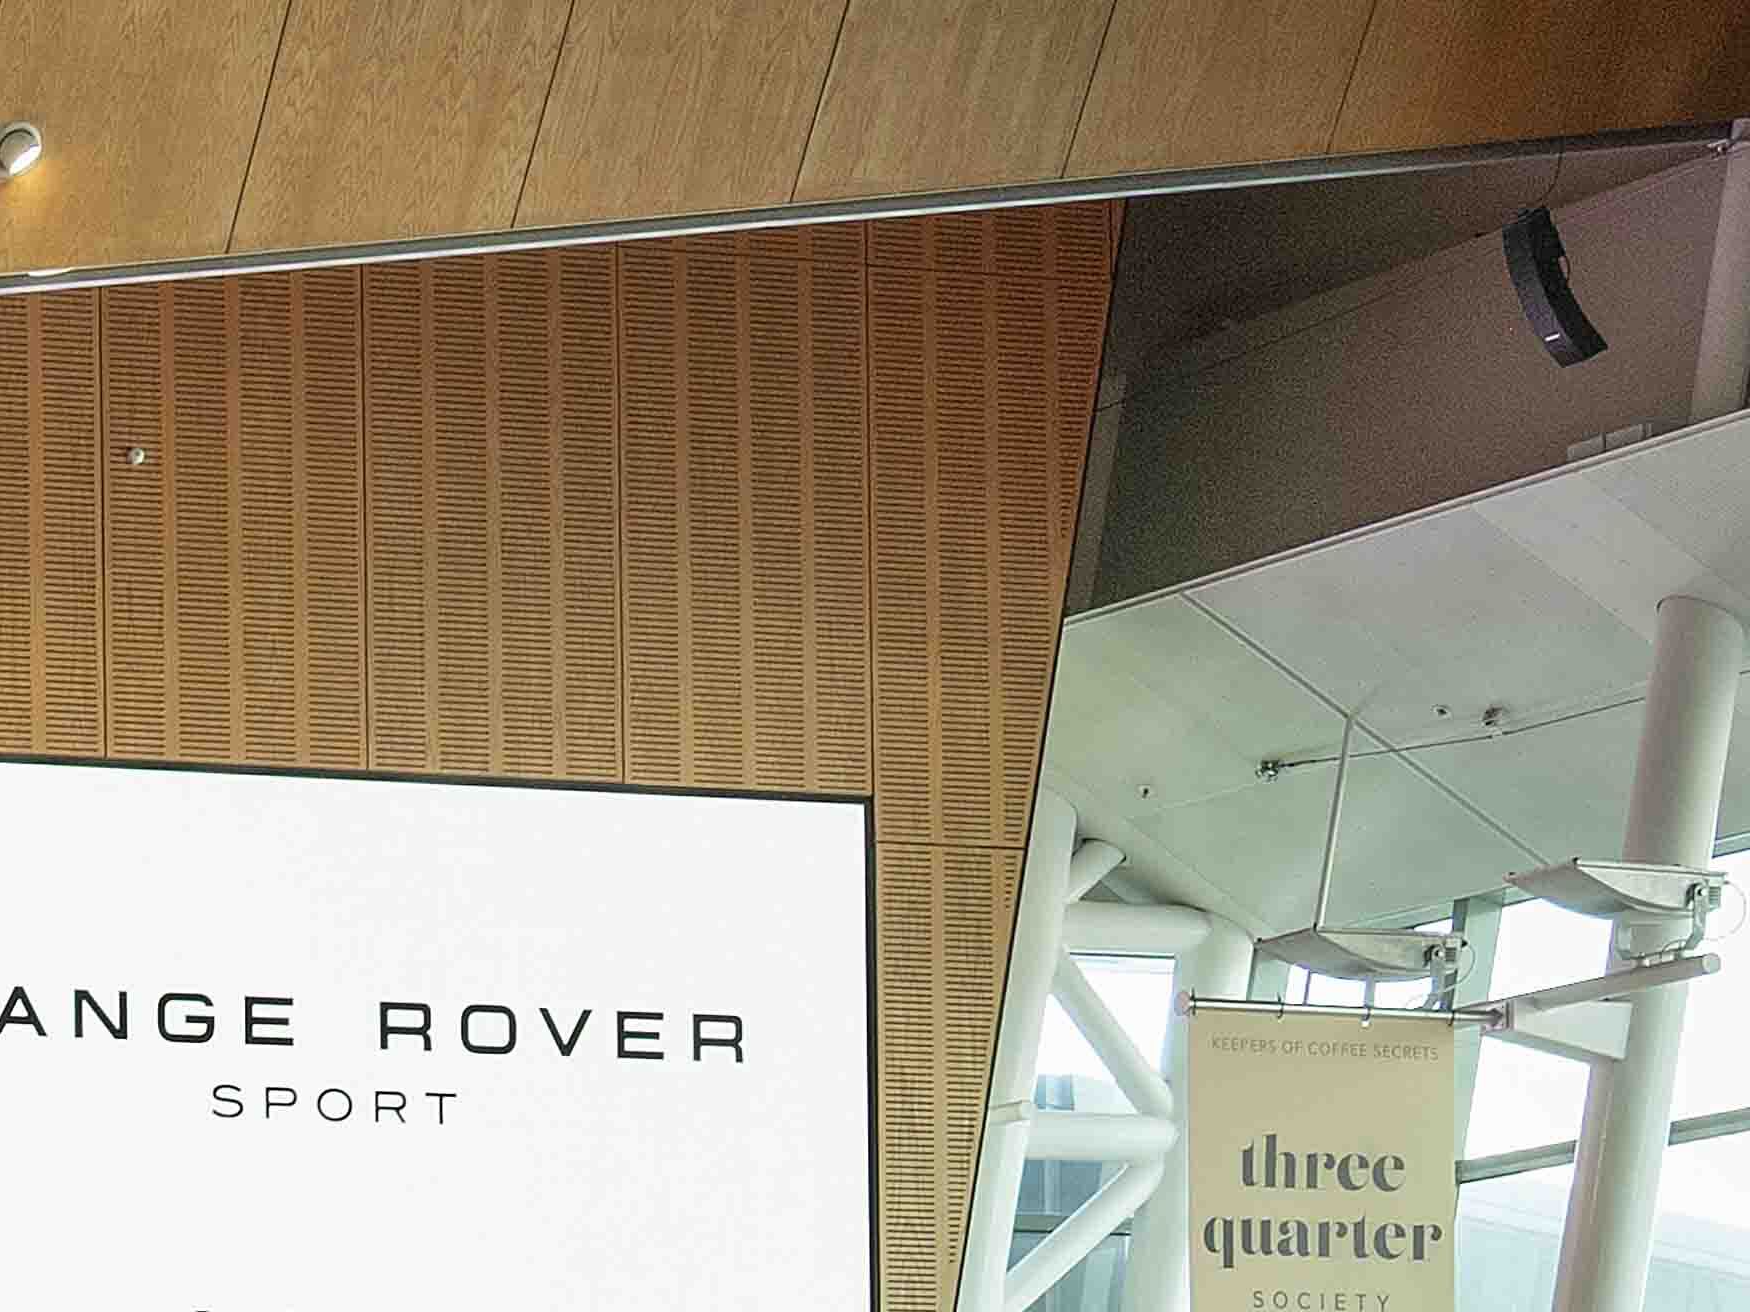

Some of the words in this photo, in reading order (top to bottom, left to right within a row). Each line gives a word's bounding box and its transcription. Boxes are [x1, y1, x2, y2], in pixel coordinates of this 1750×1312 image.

[379, 1001, 744, 1064] ROVER
[1211, 1036, 1278, 1052] KEEPERS
[1281, 1040, 1303, 1054] OF
[1308, 1041, 1367, 1057] COFFEE
[1373, 1043, 1439, 1061] SECRETS
[212, 1084, 457, 1125] SPORT
[1242, 1133, 1405, 1193] three
[1203, 1215, 1443, 1269] quarter
[1253, 1290, 1390, 1312] SOCIETY
